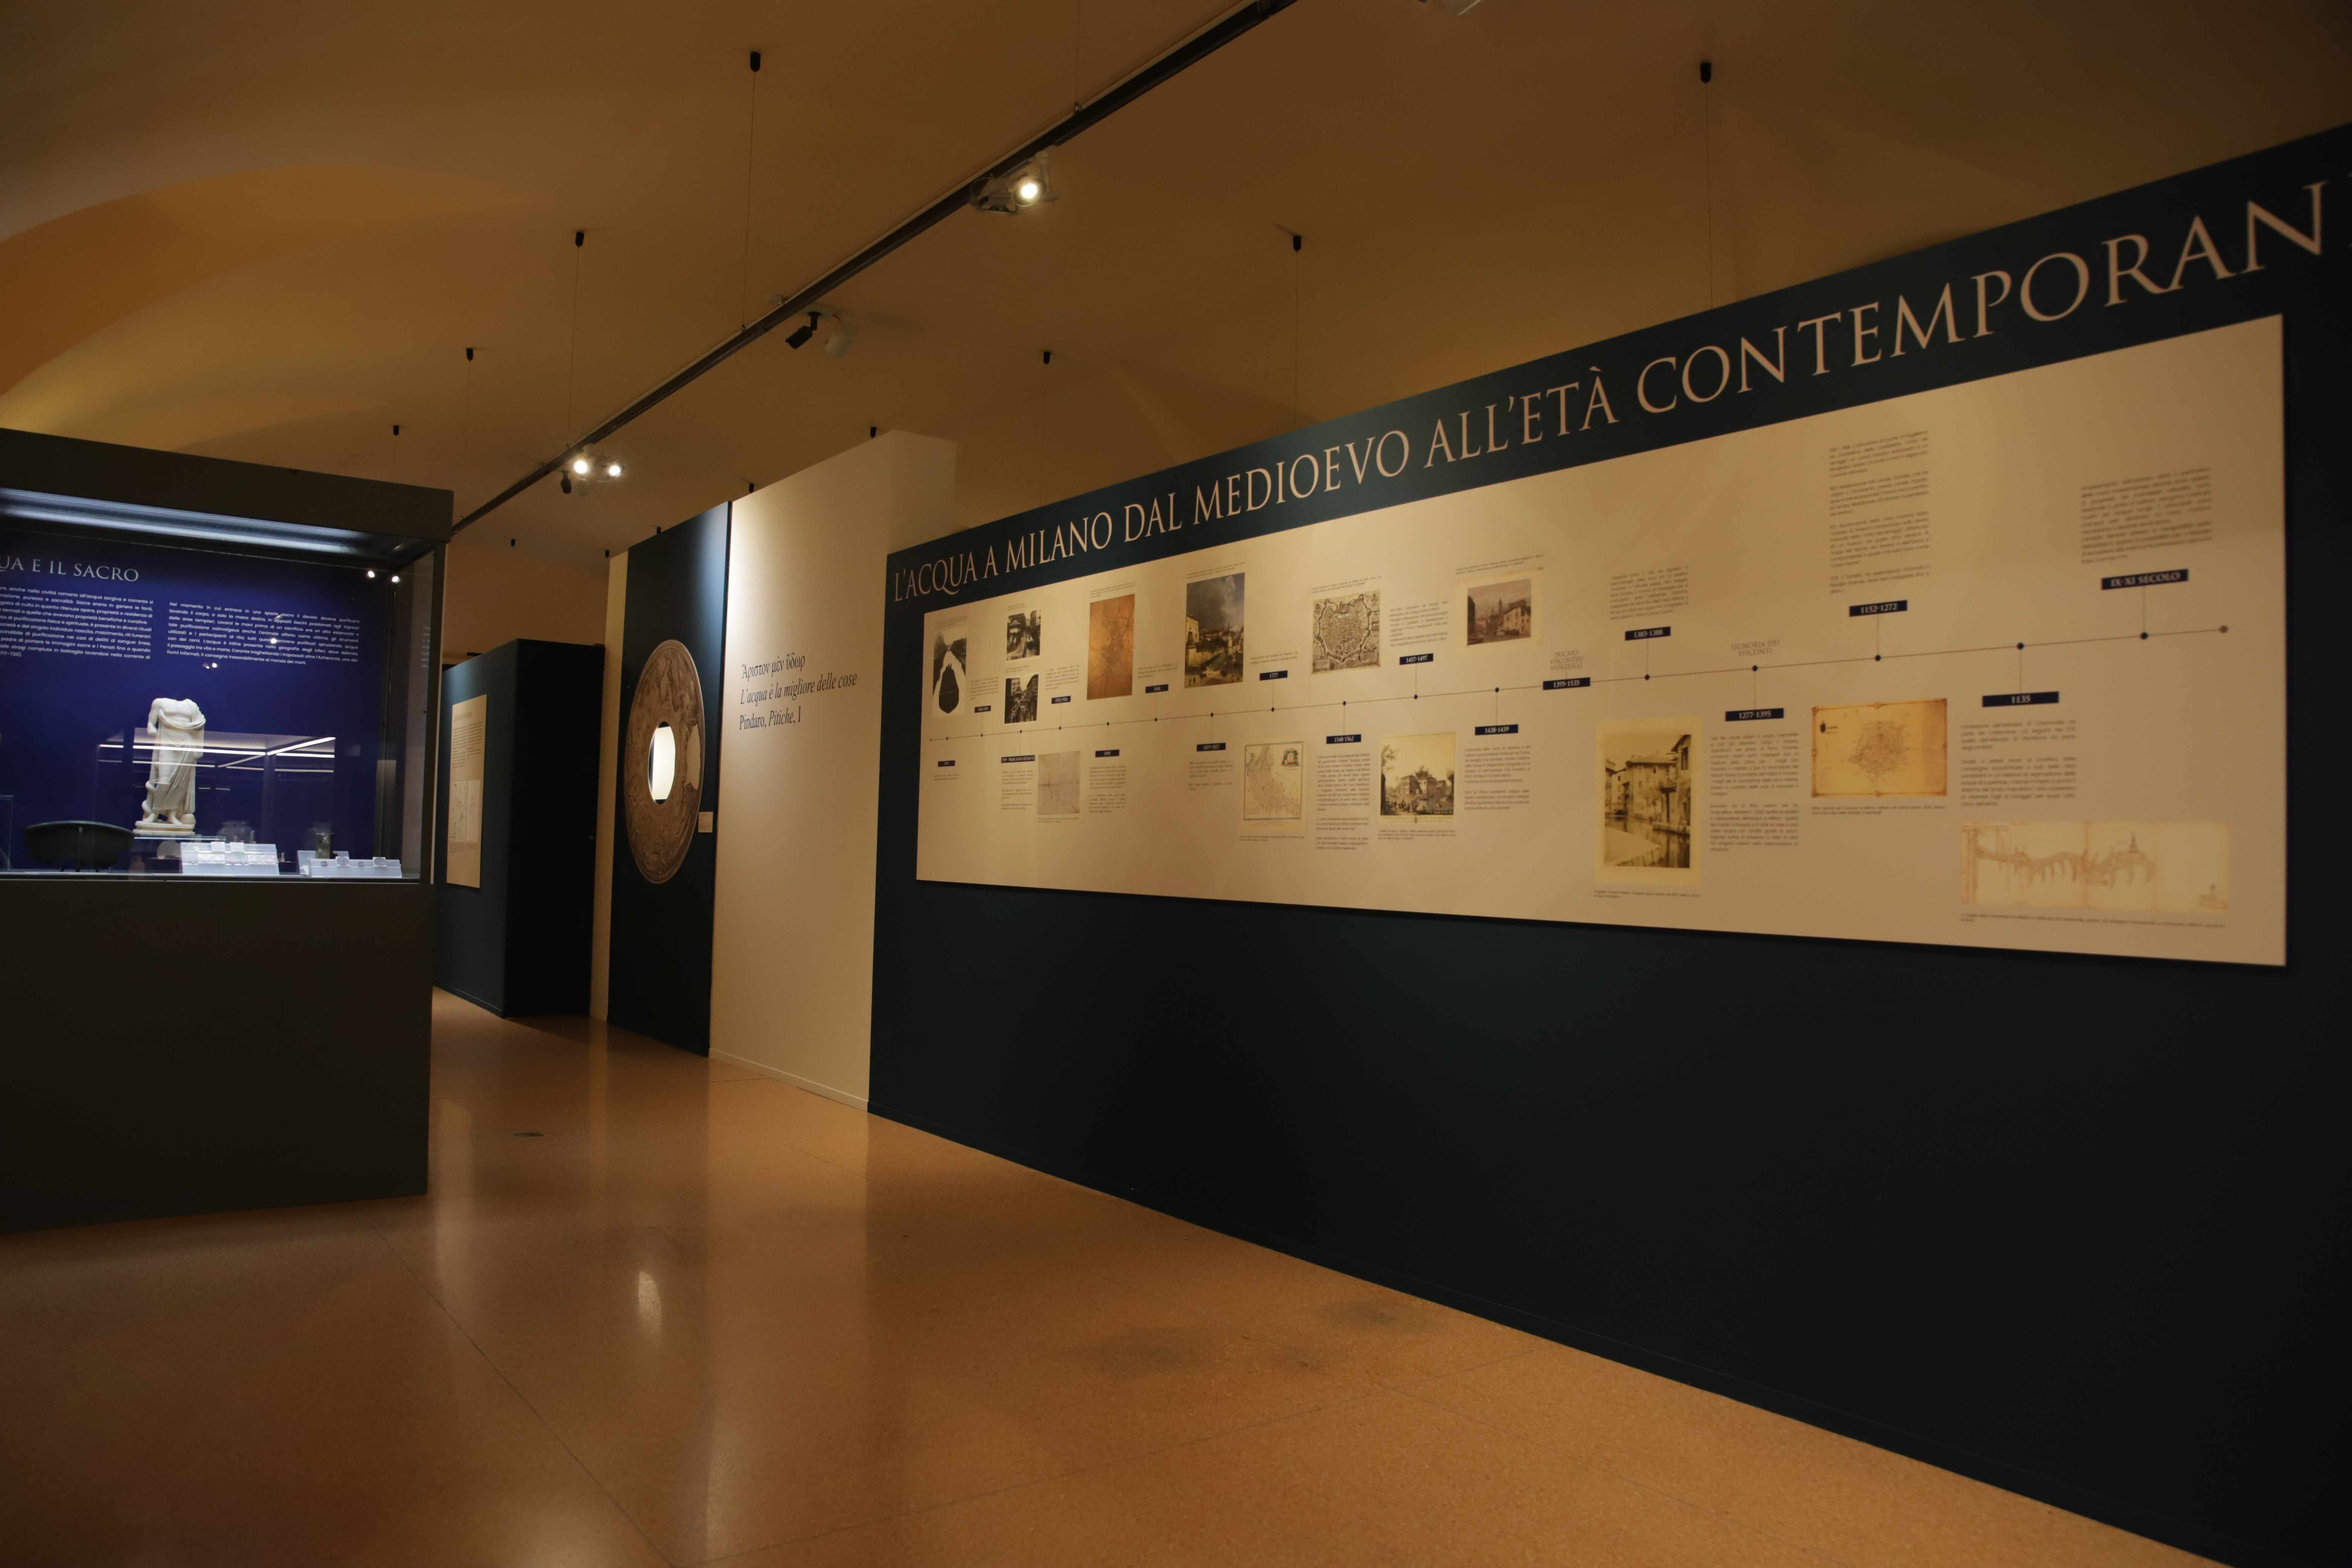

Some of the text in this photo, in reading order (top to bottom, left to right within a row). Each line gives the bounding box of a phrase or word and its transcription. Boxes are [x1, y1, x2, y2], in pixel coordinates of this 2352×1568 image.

[894, 172, 2352, 602] L'ACQUA A MILANO DAL MEDIOEVO ALL'ETÀ CONTEMPORAN
[32, 559, 41, 573] E
[49, 560, 66, 575] IL
[74, 563, 139, 582] SACRO
[2138, 572, 2180, 584] SECOLO
[1738, 648, 1772, 656] VISCONTI
[740, 672, 858, 707] L'acqua è la migliore delle cose
[2011, 695, 2031, 703] 1135
[740, 706, 802, 730] Pindaro, Pitiche, I
